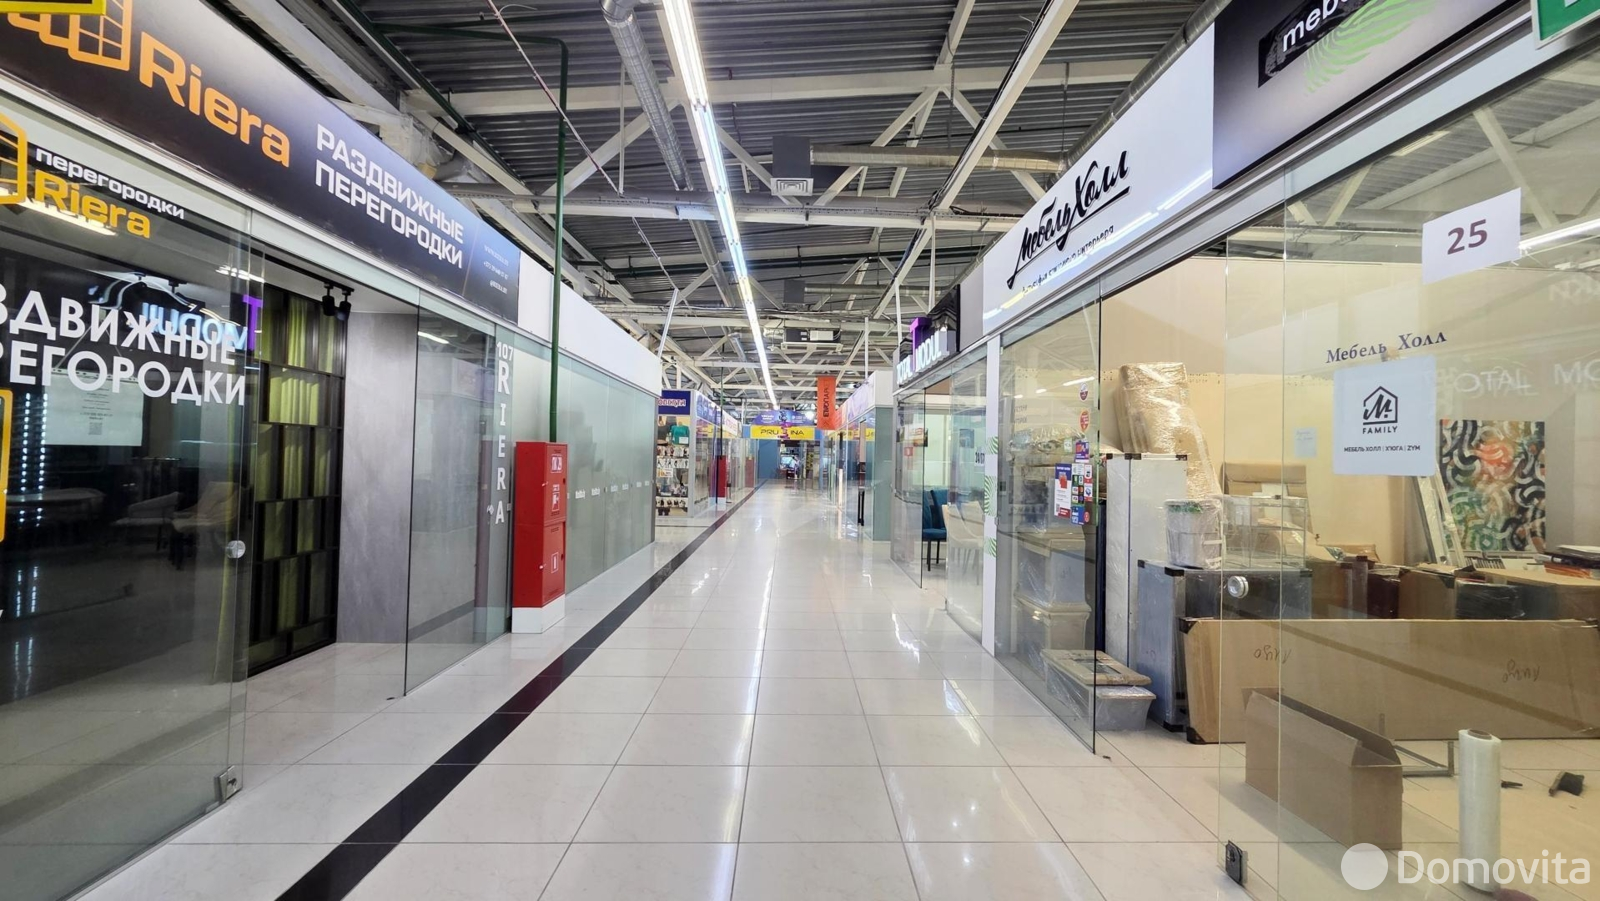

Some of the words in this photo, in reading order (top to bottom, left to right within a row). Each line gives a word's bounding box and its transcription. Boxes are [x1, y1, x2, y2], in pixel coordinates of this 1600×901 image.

[1283, 0, 1347, 52] meb
[139, 31, 291, 168] Riera
[34, 169, 151, 239] Riera
[35, 148, 185, 220] перегородки
[315, 159, 463, 269] ПЕРЕГОРОДКИ
[316, 123, 464, 244] РАЗДВИЖНЫЕ
[1447, 219, 1488, 255] 25
[0, 340, 245, 406] ЕГОРОДКИ
[496, 341, 514, 361] 107
[1326, 343, 1387, 363] Мебель
[1398, 332, 1447, 350] Холл
[494, 360, 511, 525] RIERA
[1362, 426, 1398, 434] FAMILY
